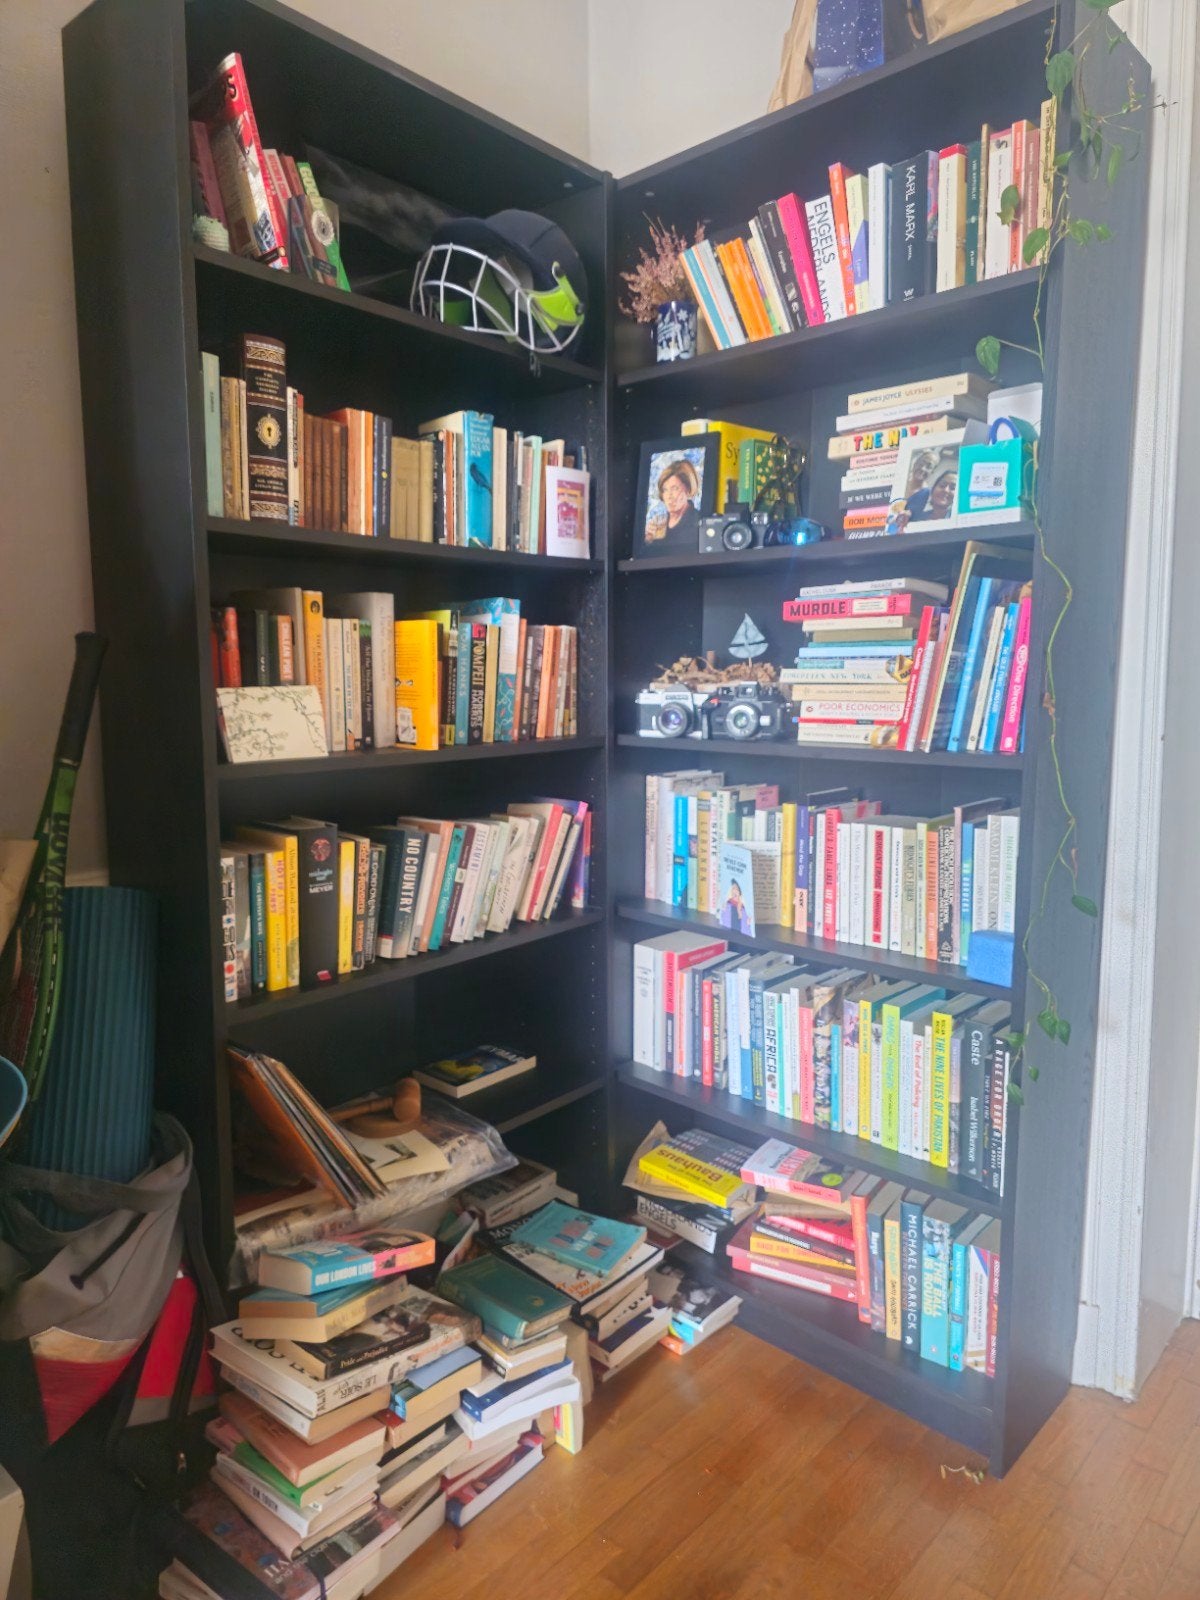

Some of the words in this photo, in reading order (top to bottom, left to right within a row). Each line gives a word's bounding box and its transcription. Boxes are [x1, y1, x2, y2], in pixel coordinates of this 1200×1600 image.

[905, 165, 919, 201] KARL
[814, 202, 835, 264] ENGELS
[904, 202, 918, 241] MARX
[854, 431, 883, 452] THE
[789, 601, 847, 617] MURDLE
[459, 657, 469, 698] HANKS
[472, 639, 485, 686] POMPEII
[852, 672, 873, 681] YORK
[1014, 664, 1026, 682] One
[470, 689, 478, 728] HARRIS
[818, 702, 843, 712] POOR
[845, 701, 901, 712] ECONOMICS
[1008, 684, 1022, 724] Direction
[407, 838, 422, 854] NO
[699, 820, 709, 882] LEBANON
[990, 820, 1000, 865] NAOMI
[399, 856, 420, 914] COUNTRY
[797, 864, 805, 877] Gap
[990, 867, 1000, 905] KLEIN
[308, 886, 334, 894] MEYER
[766, 1028, 777, 1074] AFRICA
[935, 1037, 946, 1053] THE
[970, 1029, 983, 1066] Caste
[935, 1054, 945, 1075] NINE
[994, 1049, 1003, 1077] RAGE
[935, 1076, 945, 1100] LIVES
[994, 1080, 1003, 1100] FOR
[934, 1101, 944, 1113] OF
[969, 1096, 981, 1122] Isabel
[933, 1114, 944, 1153] PAKISTAN
[968, 1122, 979, 1163] Wilkerson
[657, 1148, 723, 1183] Bauhaus
[638, 1202, 677, 1231] ENGELS
[906, 1214, 918, 1271] MICHAEL
[923, 1257, 933, 1270] IS
[933, 1261, 943, 1286] THE
[906, 1275, 917, 1330] CARRICK
[923, 1272, 934, 1316] ROUND
[934, 1287, 944, 1319] BALL
[340, 1358, 358, 1369] Pride
[364, 1346, 389, 1359] Prejudice
